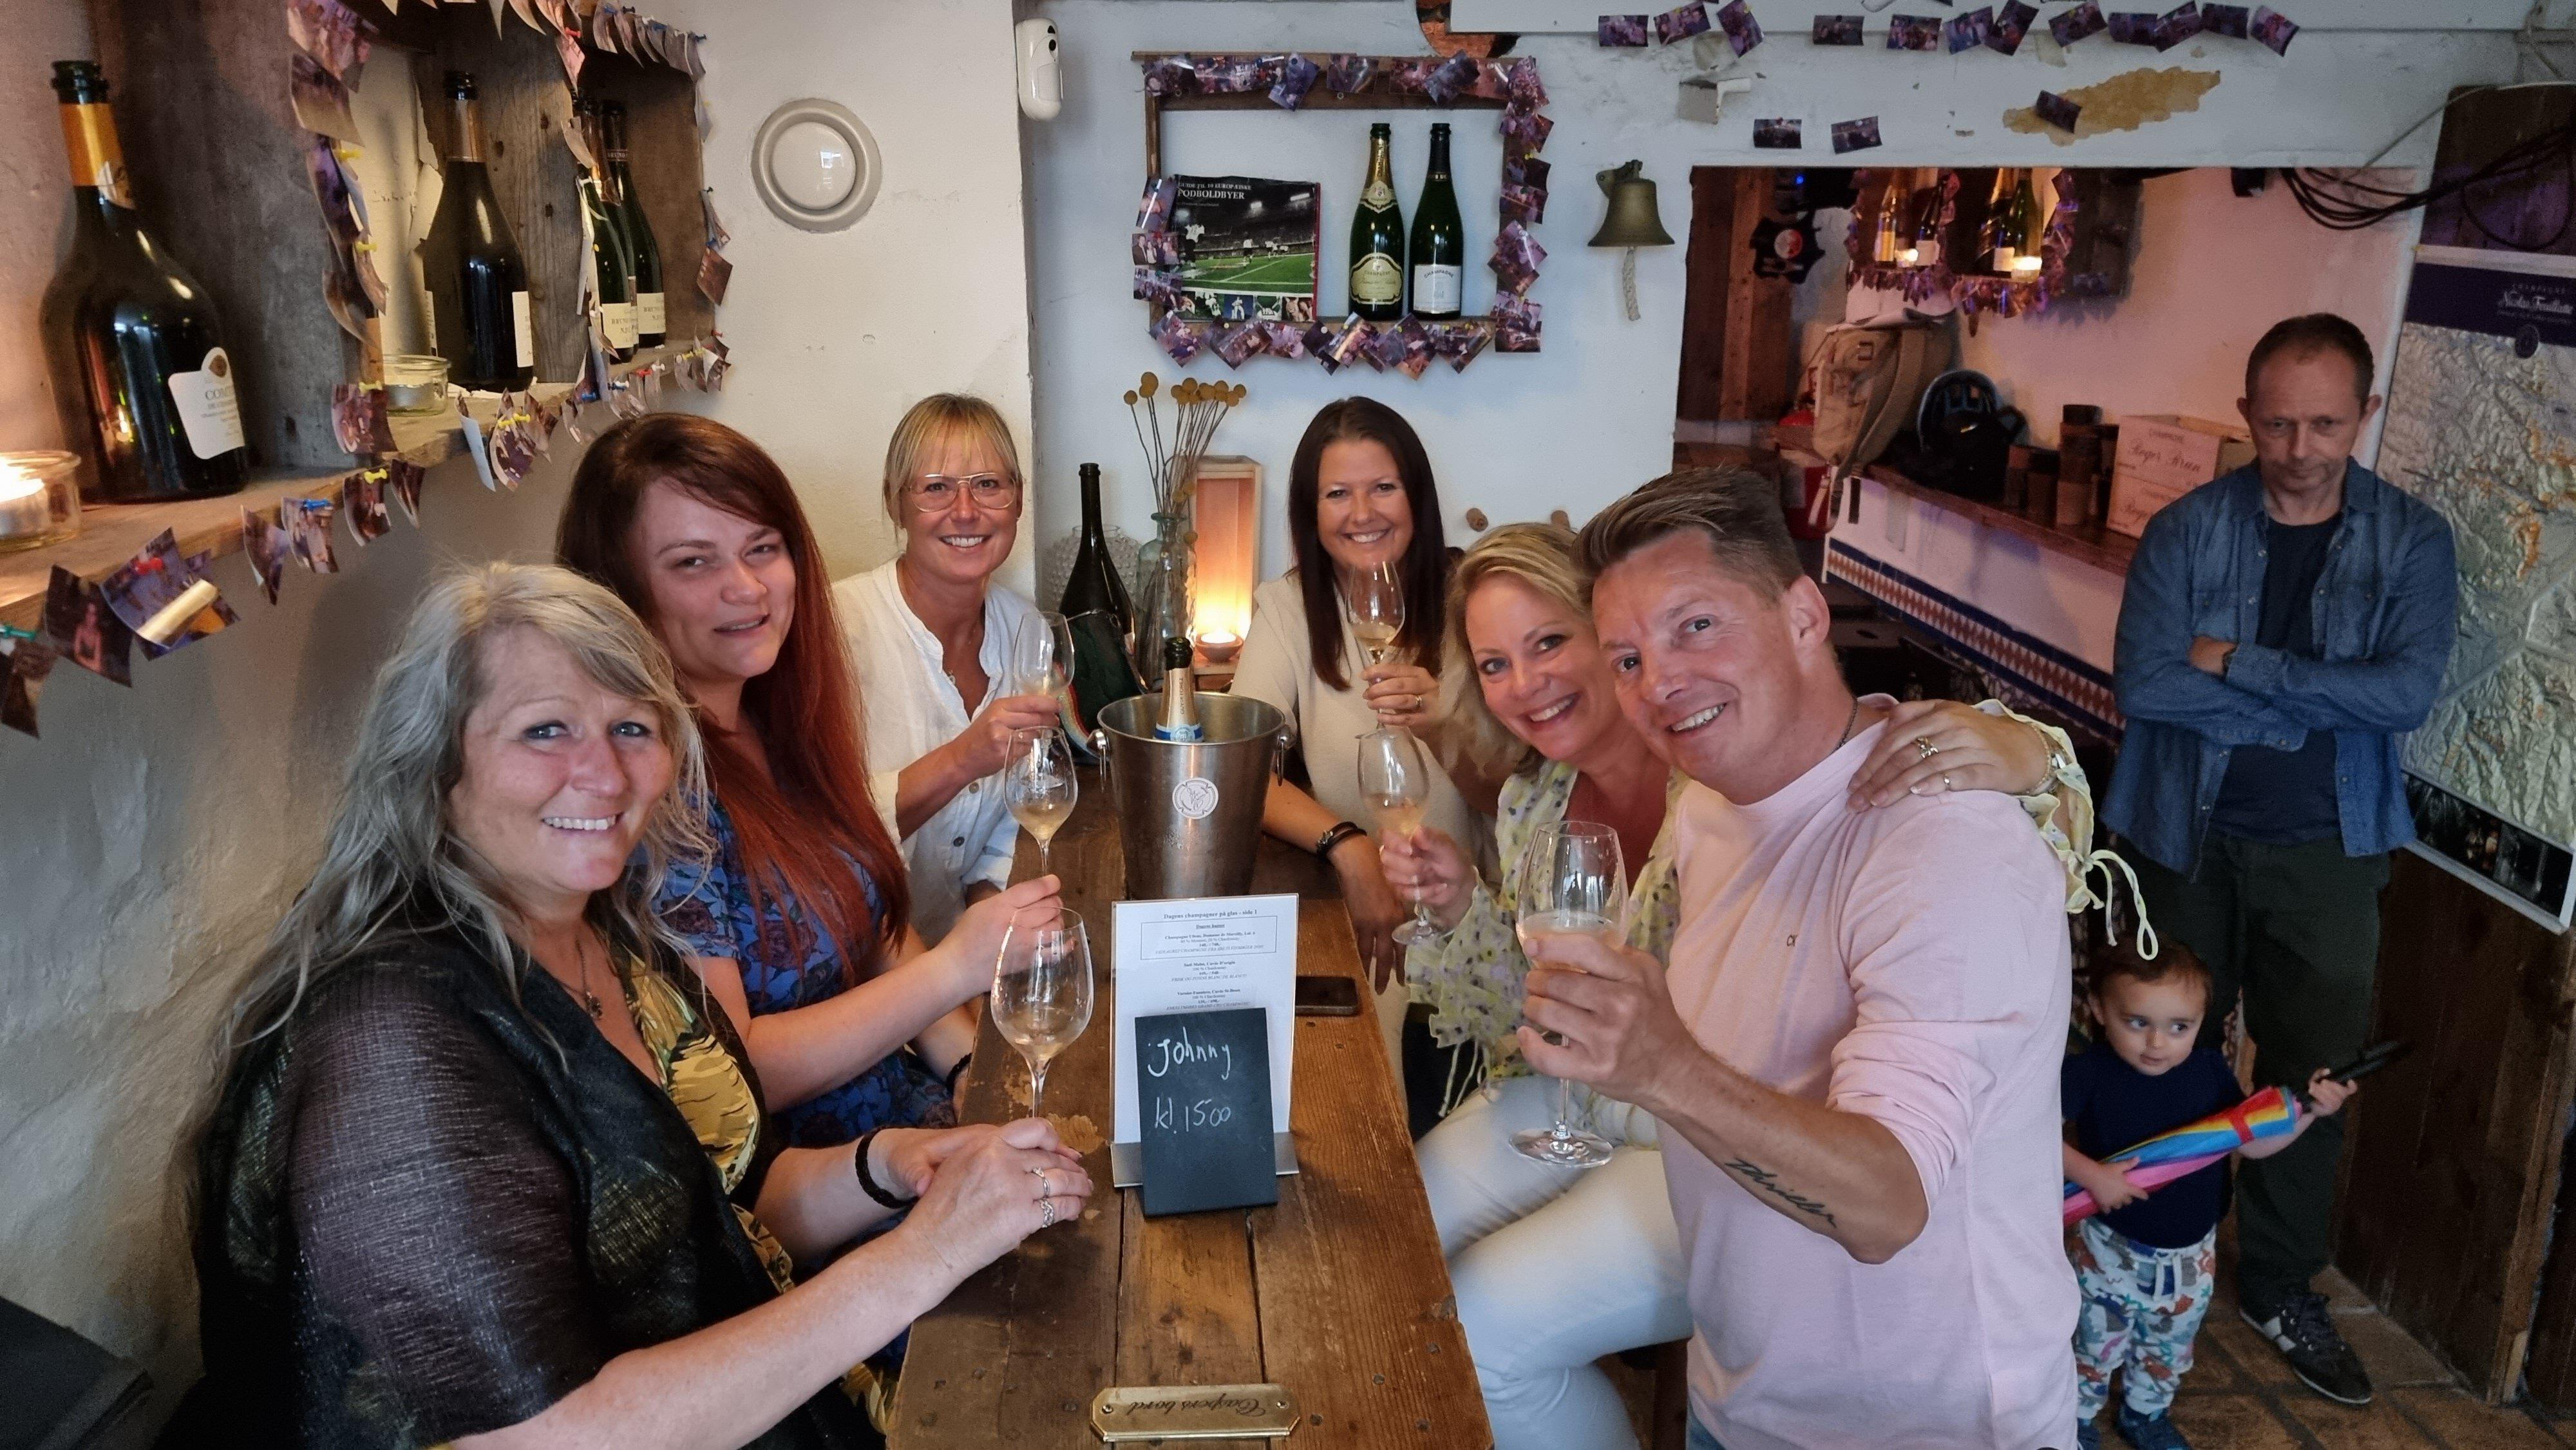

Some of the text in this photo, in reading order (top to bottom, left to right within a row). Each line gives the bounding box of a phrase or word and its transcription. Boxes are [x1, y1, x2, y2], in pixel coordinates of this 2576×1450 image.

[1177, 190, 1245, 200] FODBOLDBYER
[1423, 269, 1454, 278] CHAMPAGNE
[1148, 1026, 1231, 1080] Johnny
[1126, 1400, 1176, 1416] bord
